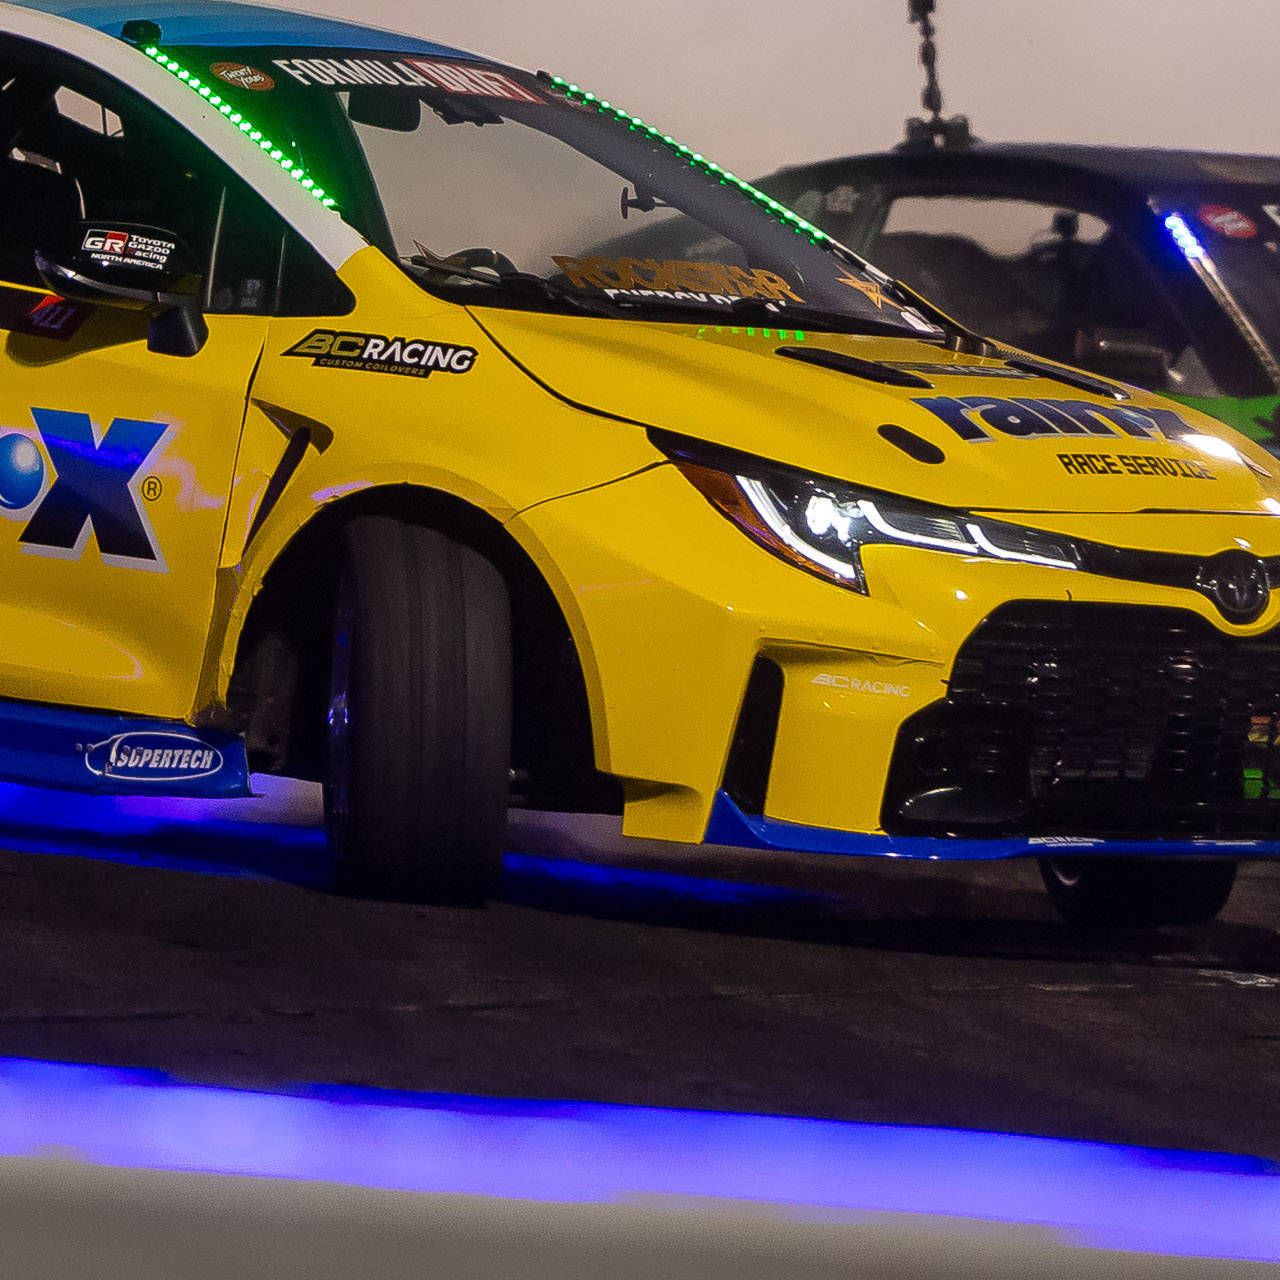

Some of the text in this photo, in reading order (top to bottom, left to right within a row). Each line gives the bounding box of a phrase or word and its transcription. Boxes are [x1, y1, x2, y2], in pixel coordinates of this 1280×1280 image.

[271, 59, 434, 87] FORMULA
[410, 60, 542, 104] DRIFT
[84, 237, 124, 254] GR
[128, 241, 170, 255] GAZOO
[130, 234, 175, 249] TOYOTA
[90, 252, 163, 270] NORTH AMERICA
[362, 338, 473, 370] RACING
[320, 357, 425, 376] CUSTOM COILOVERS
[1056, 452, 1218, 480] RACE SERVICE
[117, 746, 215, 769] SUPERTECH
